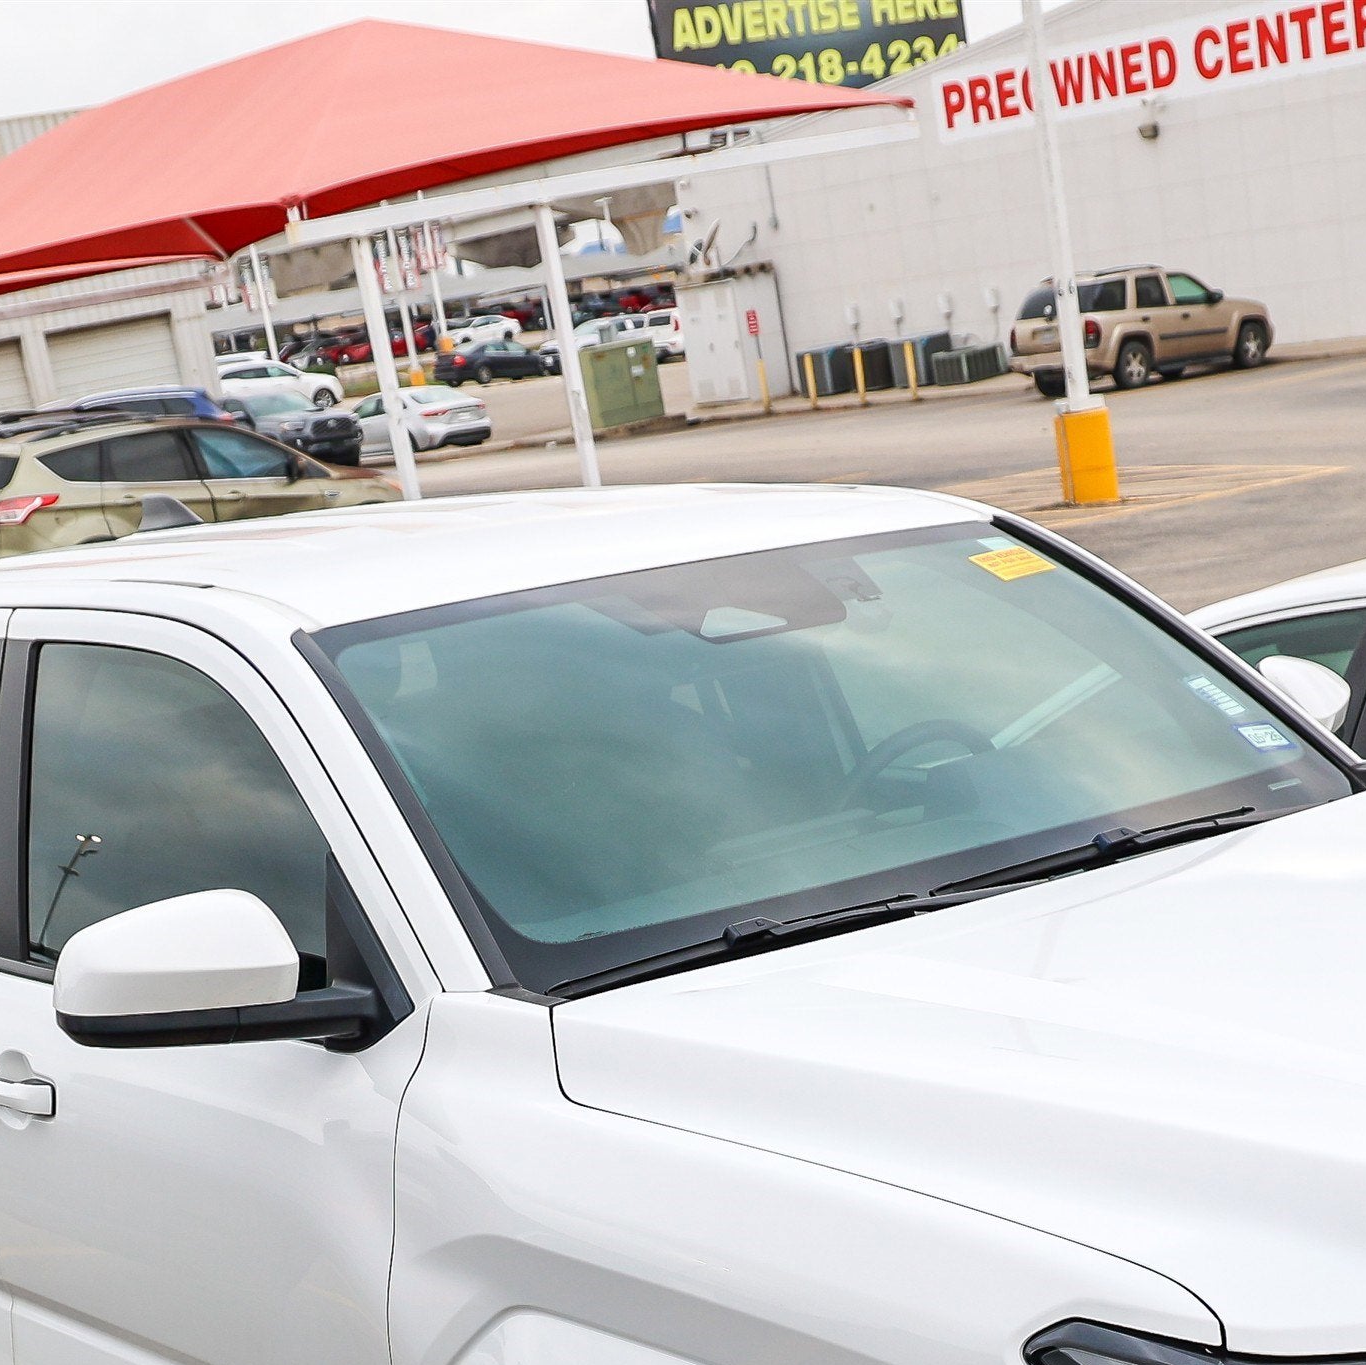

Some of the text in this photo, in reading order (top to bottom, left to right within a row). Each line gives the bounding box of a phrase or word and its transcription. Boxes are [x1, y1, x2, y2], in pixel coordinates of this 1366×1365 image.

[673, 0, 861, 51] ADVERTISE
[716, 33, 967, 85] 218-4234
[942, 38, 1178, 129] PREWNED
